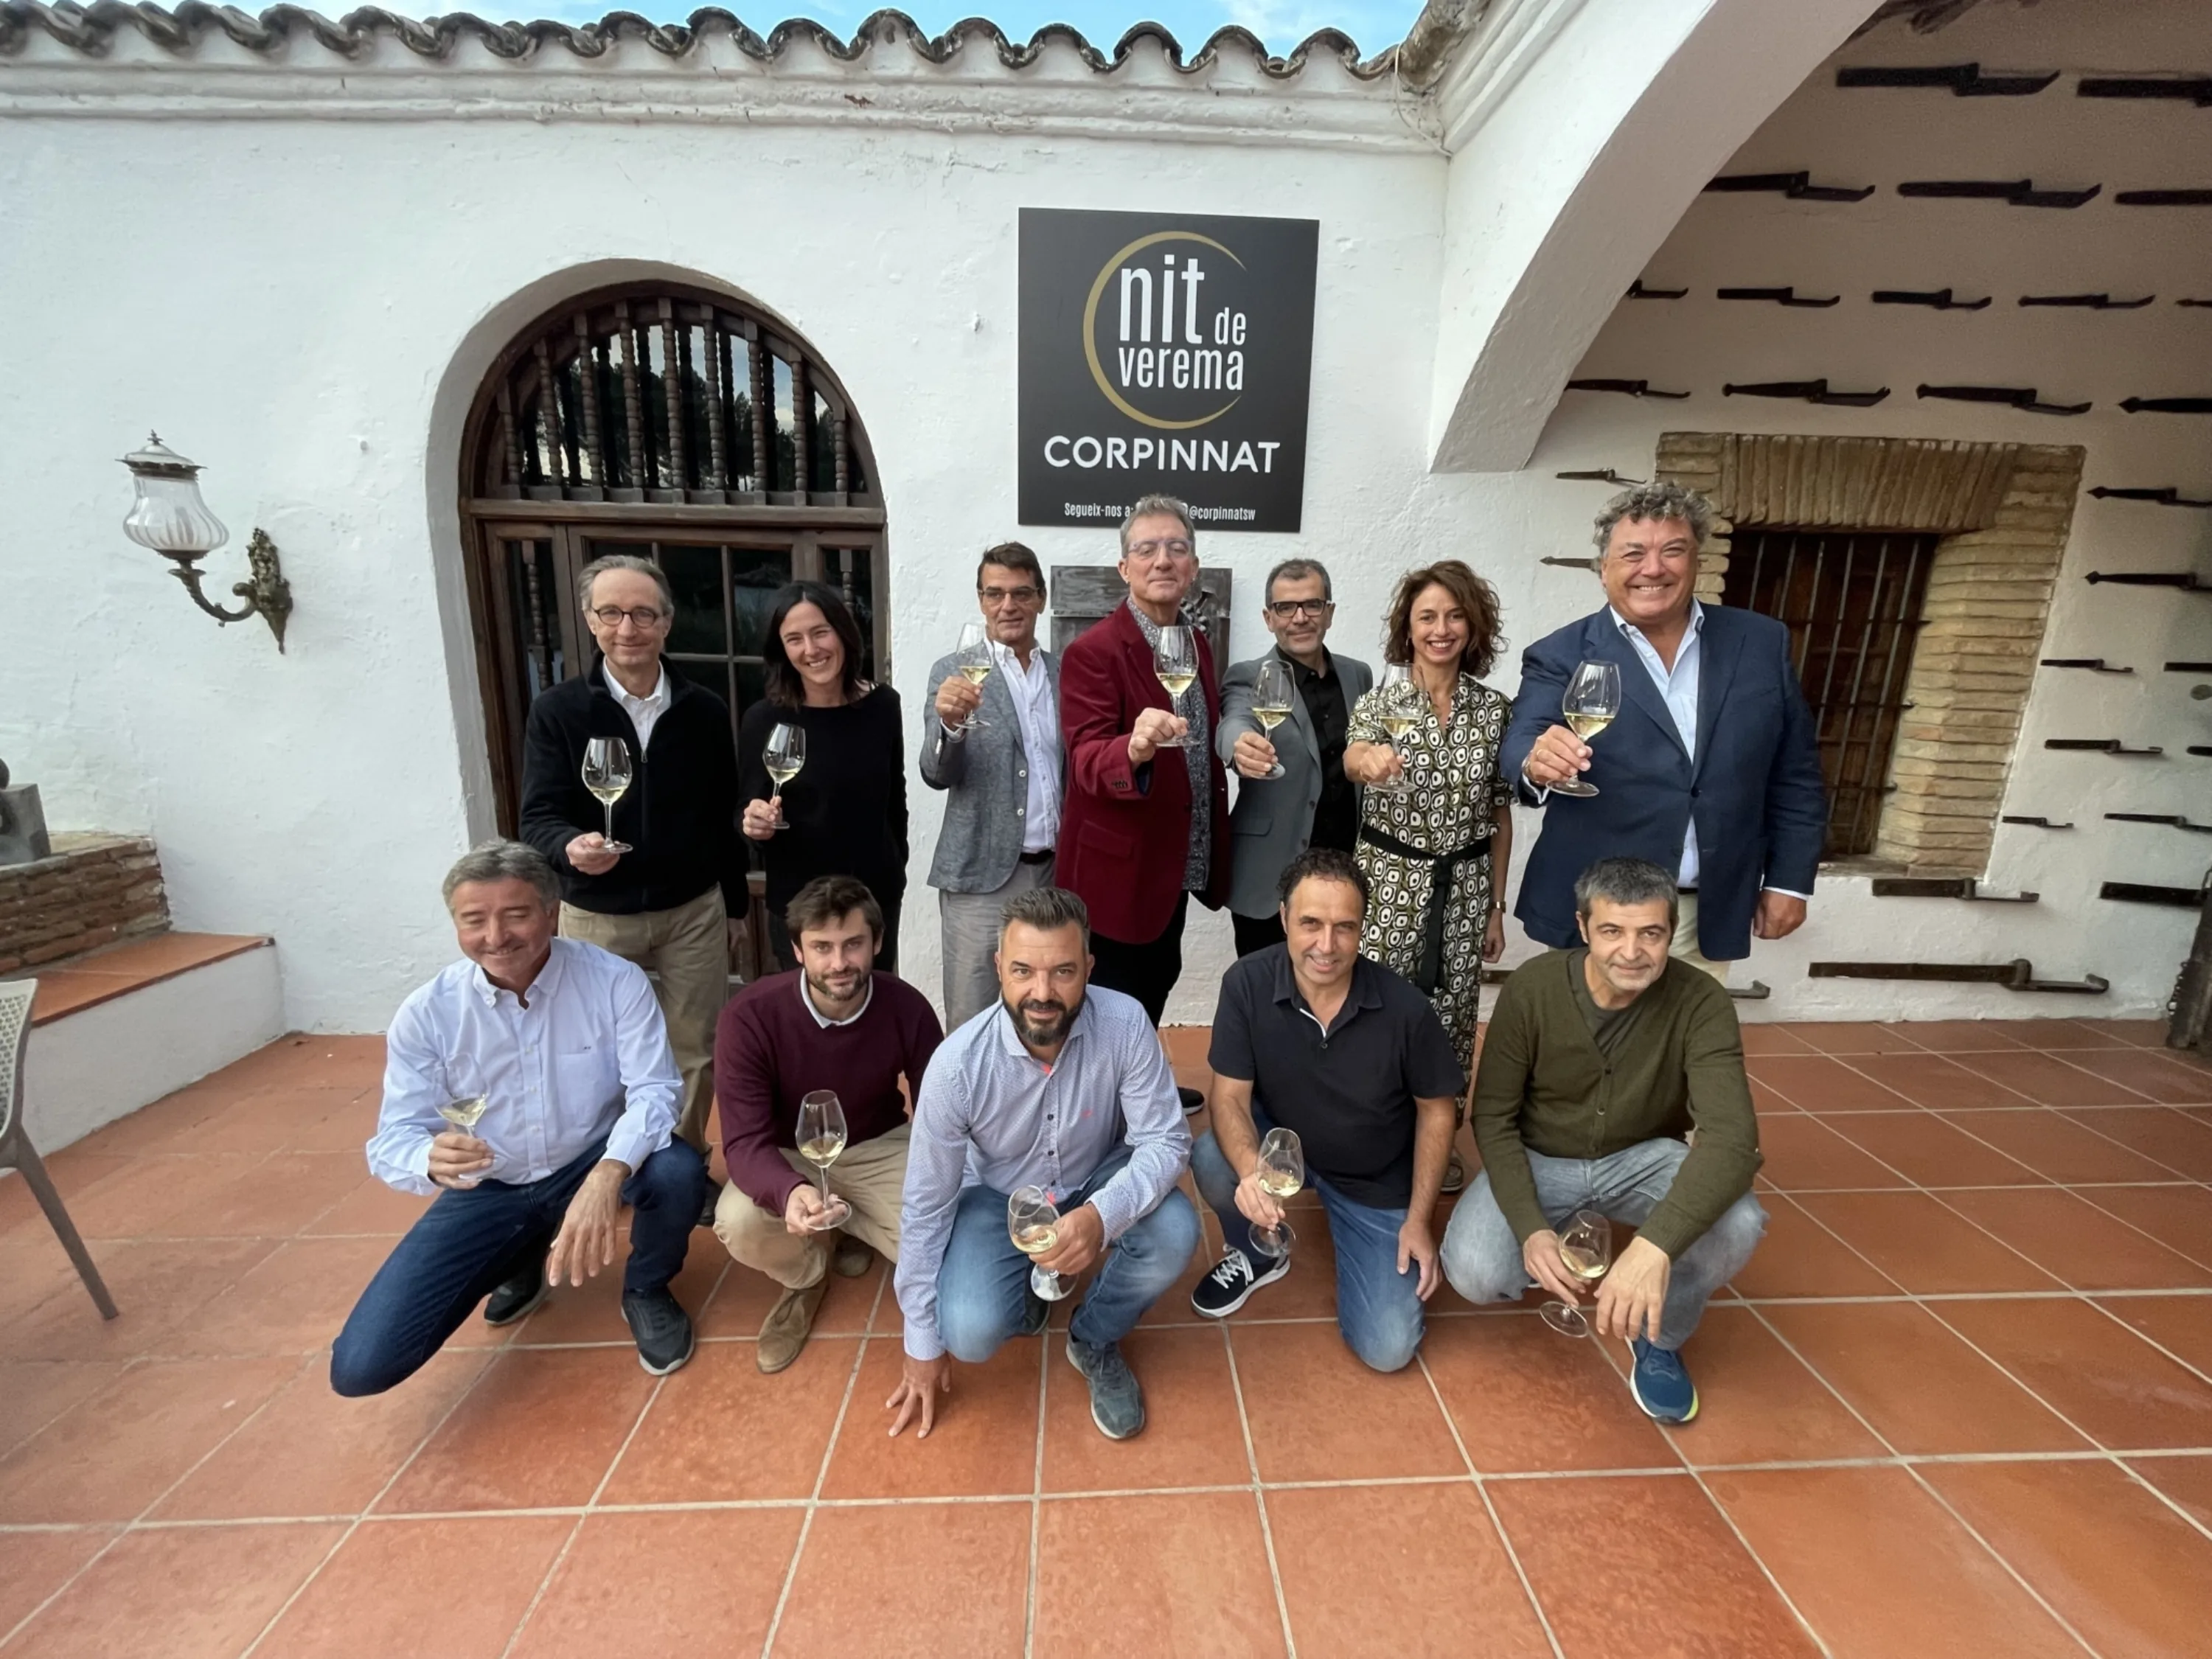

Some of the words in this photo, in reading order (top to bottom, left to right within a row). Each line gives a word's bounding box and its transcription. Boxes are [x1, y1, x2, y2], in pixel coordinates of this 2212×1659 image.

[1119, 254, 1205, 344] nit
[1214, 307, 1246, 346] de
[1119, 347, 1244, 391] verema
[1044, 435, 1281, 473] CORPINNAT
[1064, 502, 1122, 518] Segueix-nos
[1189, 505, 1256, 521] @corpinnatsw
